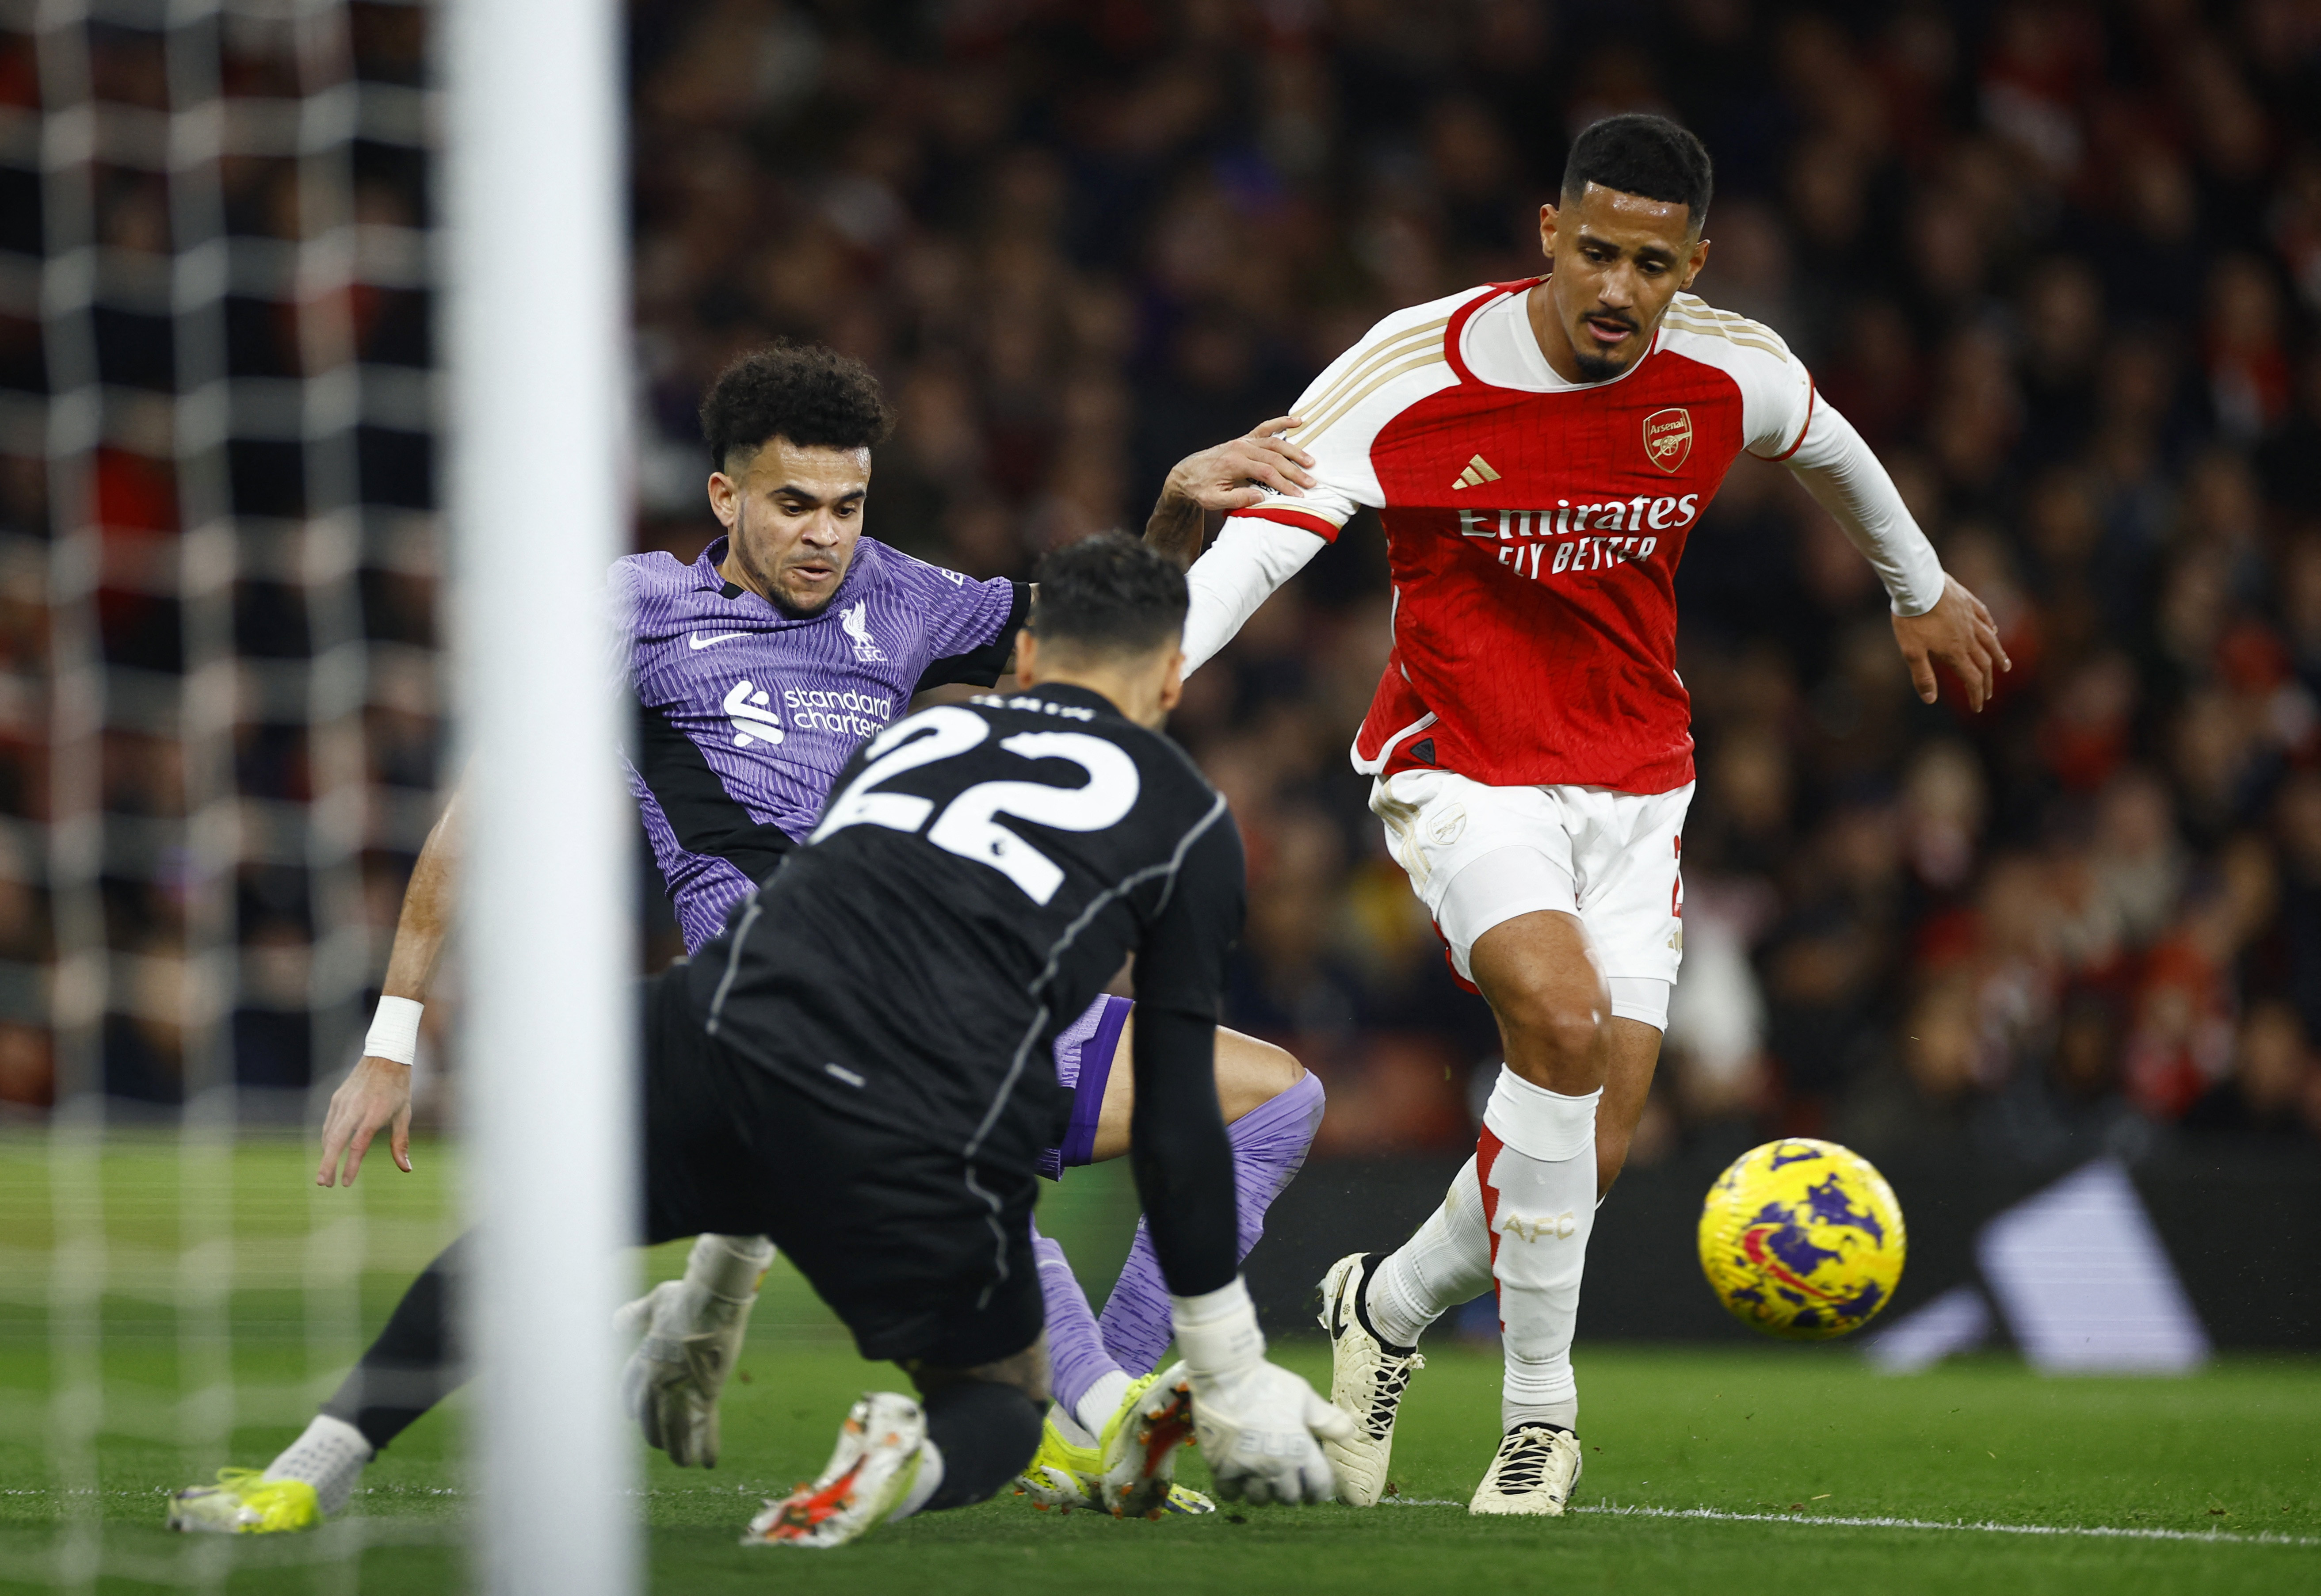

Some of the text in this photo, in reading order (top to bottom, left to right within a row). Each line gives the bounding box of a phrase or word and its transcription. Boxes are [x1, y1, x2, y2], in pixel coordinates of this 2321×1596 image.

[1650, 417, 1684, 435] Arsenal
[1458, 493, 1699, 540] Emirates
[1497, 536, 1657, 580] FLY BETTER
[784, 686, 891, 722] standard
[794, 707, 884, 739] charter
[806, 706, 1140, 906] 22
[1503, 1211, 1575, 1243] AFC
